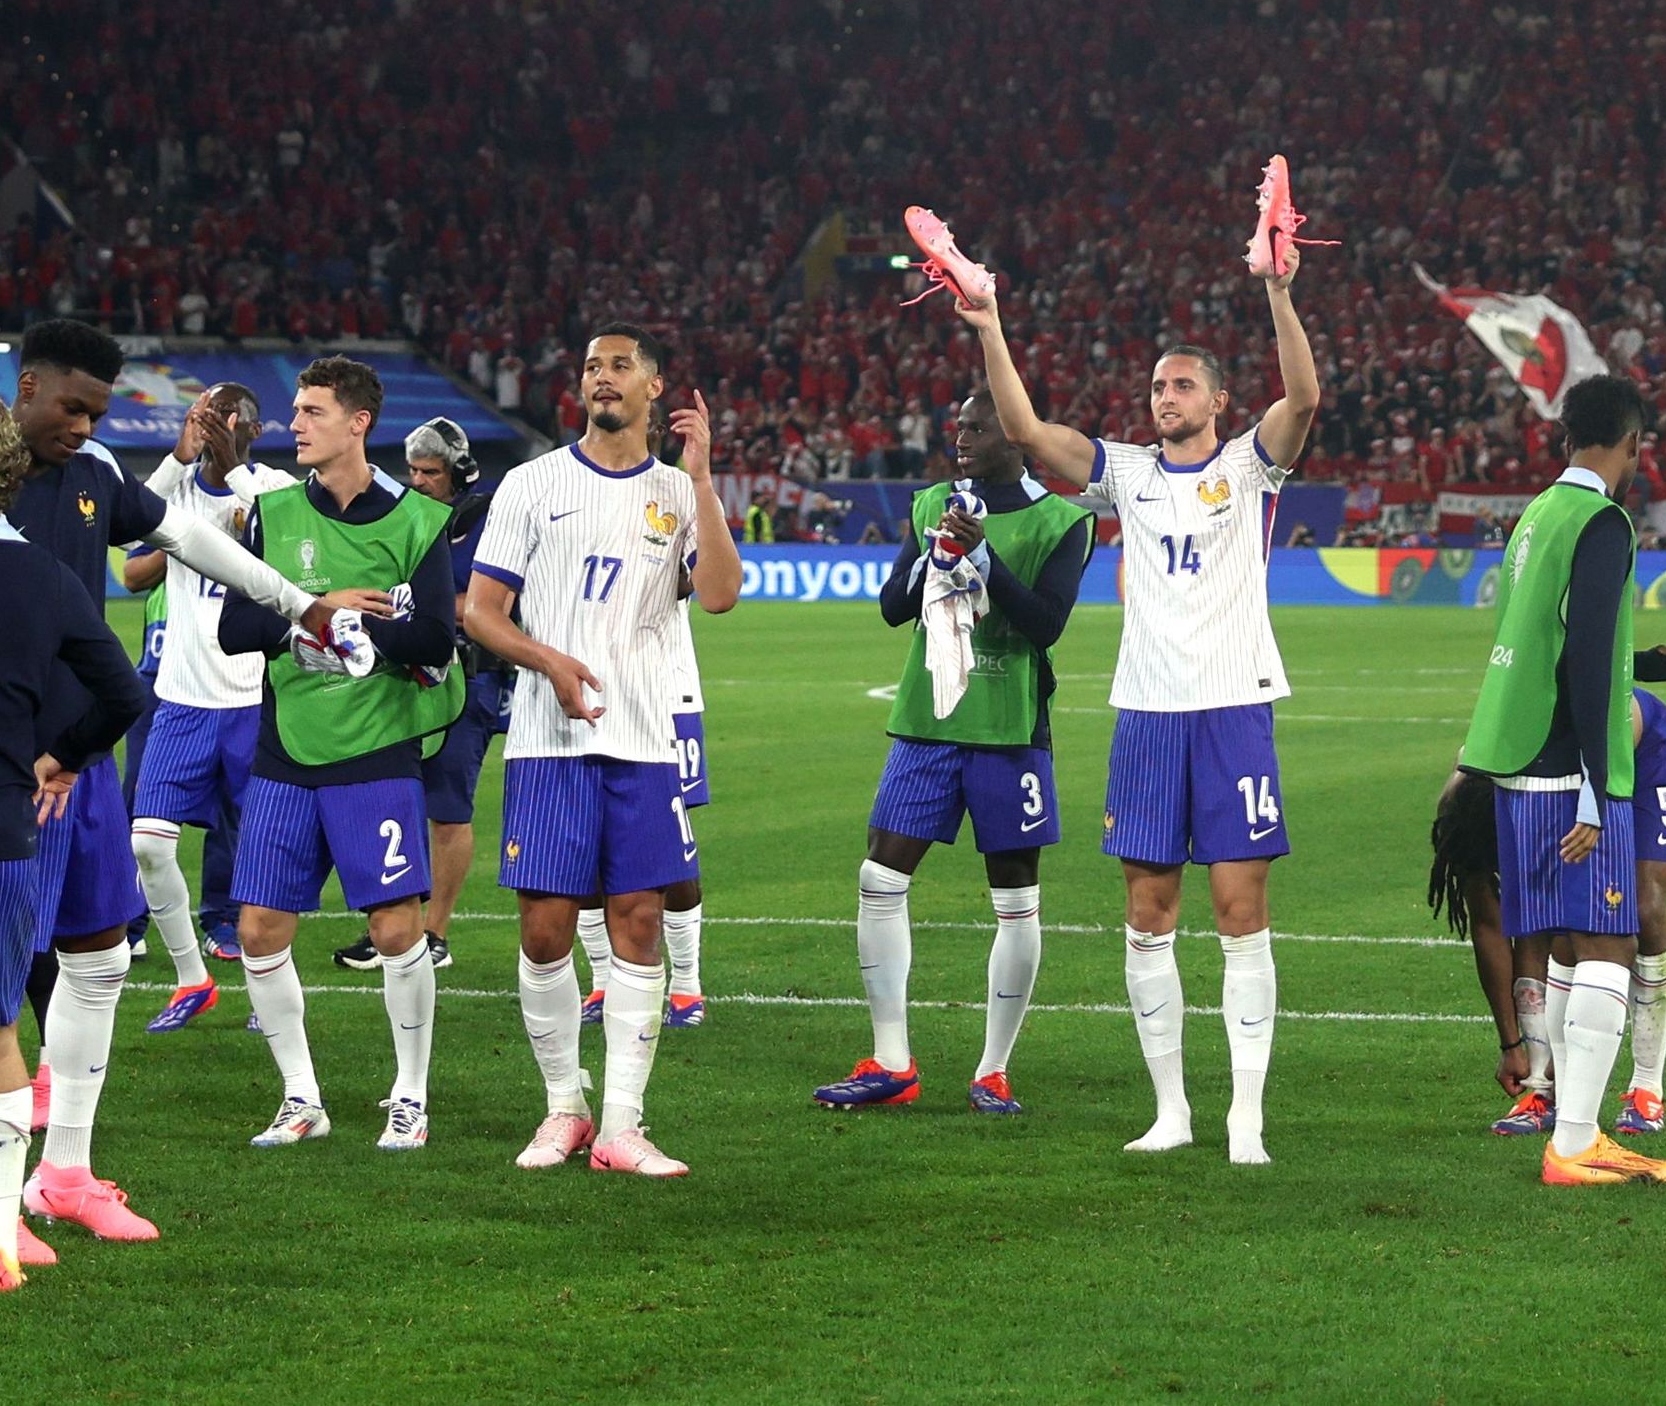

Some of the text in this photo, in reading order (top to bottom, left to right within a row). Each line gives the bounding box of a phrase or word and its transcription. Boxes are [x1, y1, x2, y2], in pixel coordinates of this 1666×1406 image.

[583, 554, 624, 604] 17
[1160, 534, 1202, 577] 14
[676, 738, 701, 779] 19
[1021, 772, 1043, 817] 3
[1238, 775, 1280, 824] 14
[379, 819, 407, 868] 2
